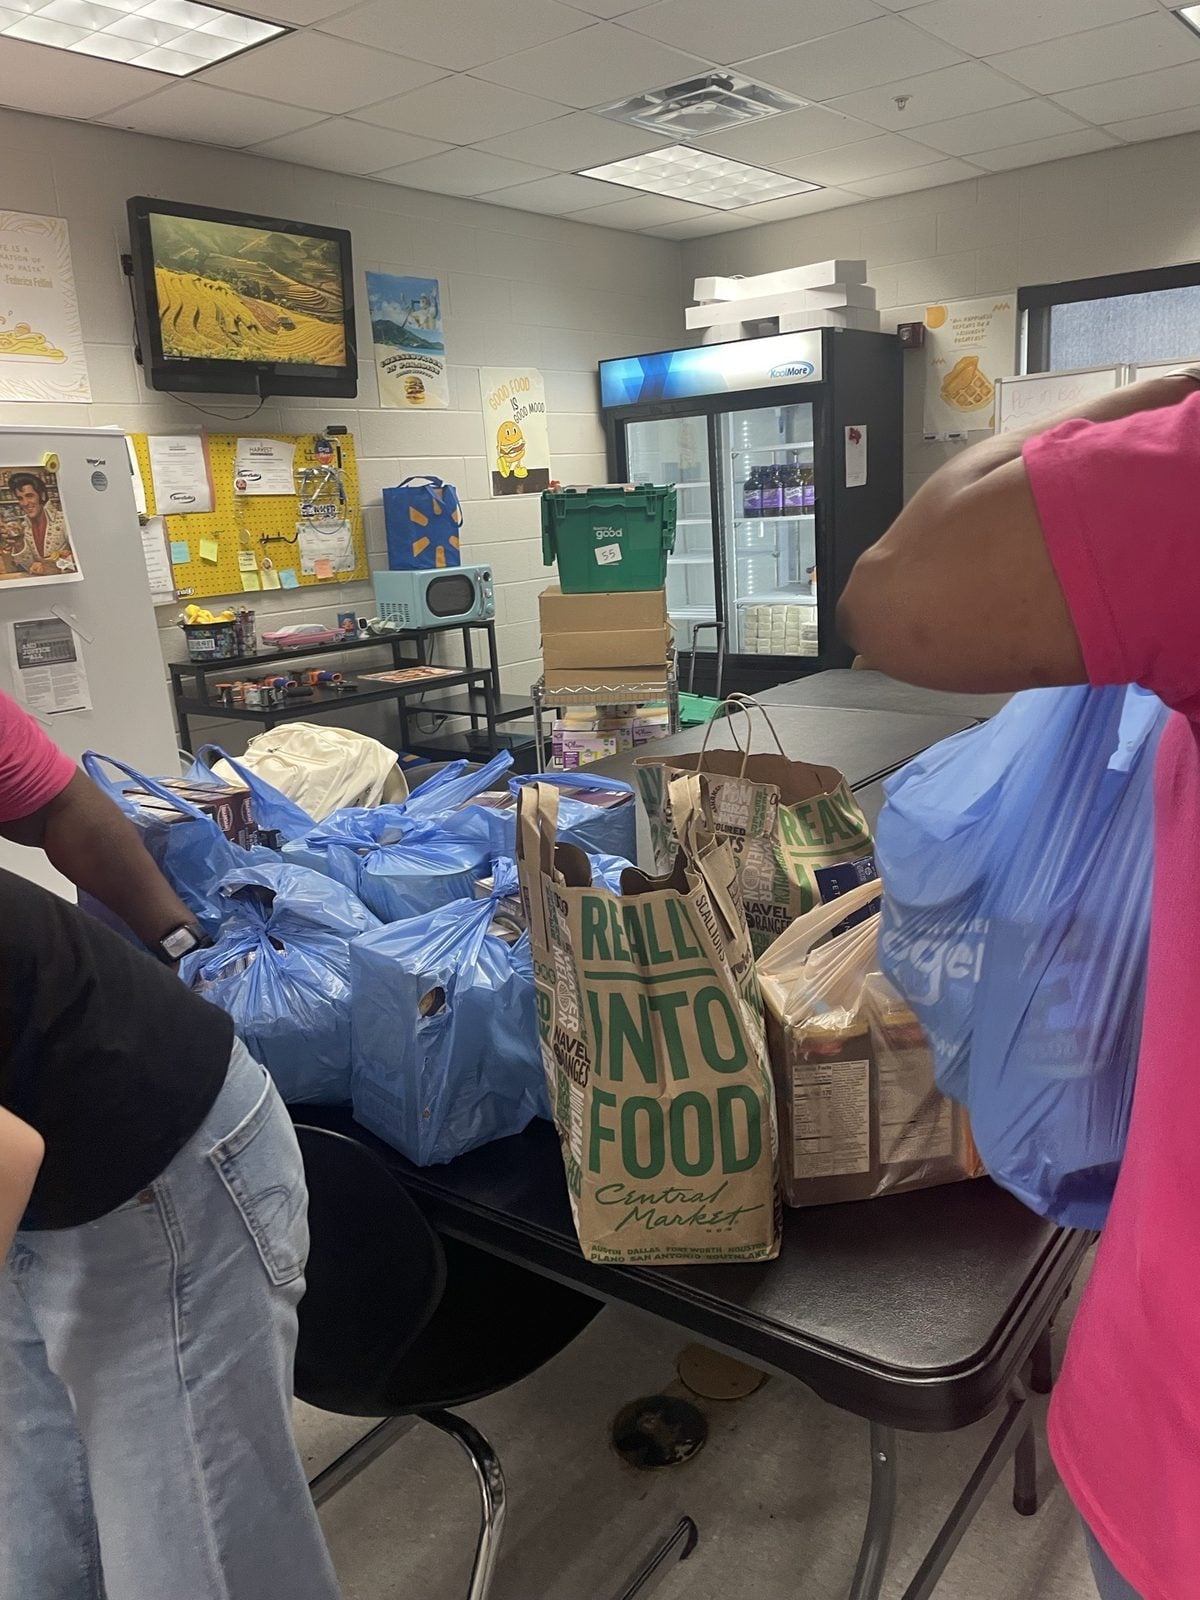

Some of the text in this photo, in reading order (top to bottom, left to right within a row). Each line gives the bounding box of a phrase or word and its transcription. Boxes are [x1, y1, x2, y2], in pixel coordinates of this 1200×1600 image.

[770, 366, 808, 379] KoolMore
[489, 376, 529, 410] GOOD FOOD
[510, 397, 518, 411] IS
[514, 402, 544, 423] GOOD MOOD
[596, 527, 623, 540] good
[743, 902, 793, 920] NAVEL
[695, 894, 726, 961] SCALLIONS
[745, 913, 793, 935] ORANGE
[554, 1025, 591, 1065] NAVEL
[587, 985, 748, 1084] INTO
[588, 1084, 762, 1180] FOOD
[595, 1180, 729, 1206] Central
[615, 1203, 766, 1232] Market
[590, 1253, 625, 1262] PLANO
[630, 1254, 651, 1263] SAN
[654, 1252, 701, 1261] ANTONIO
[591, 1245, 622, 1255] AUSTIN
[627, 1246, 661, 1255] DALLAS
